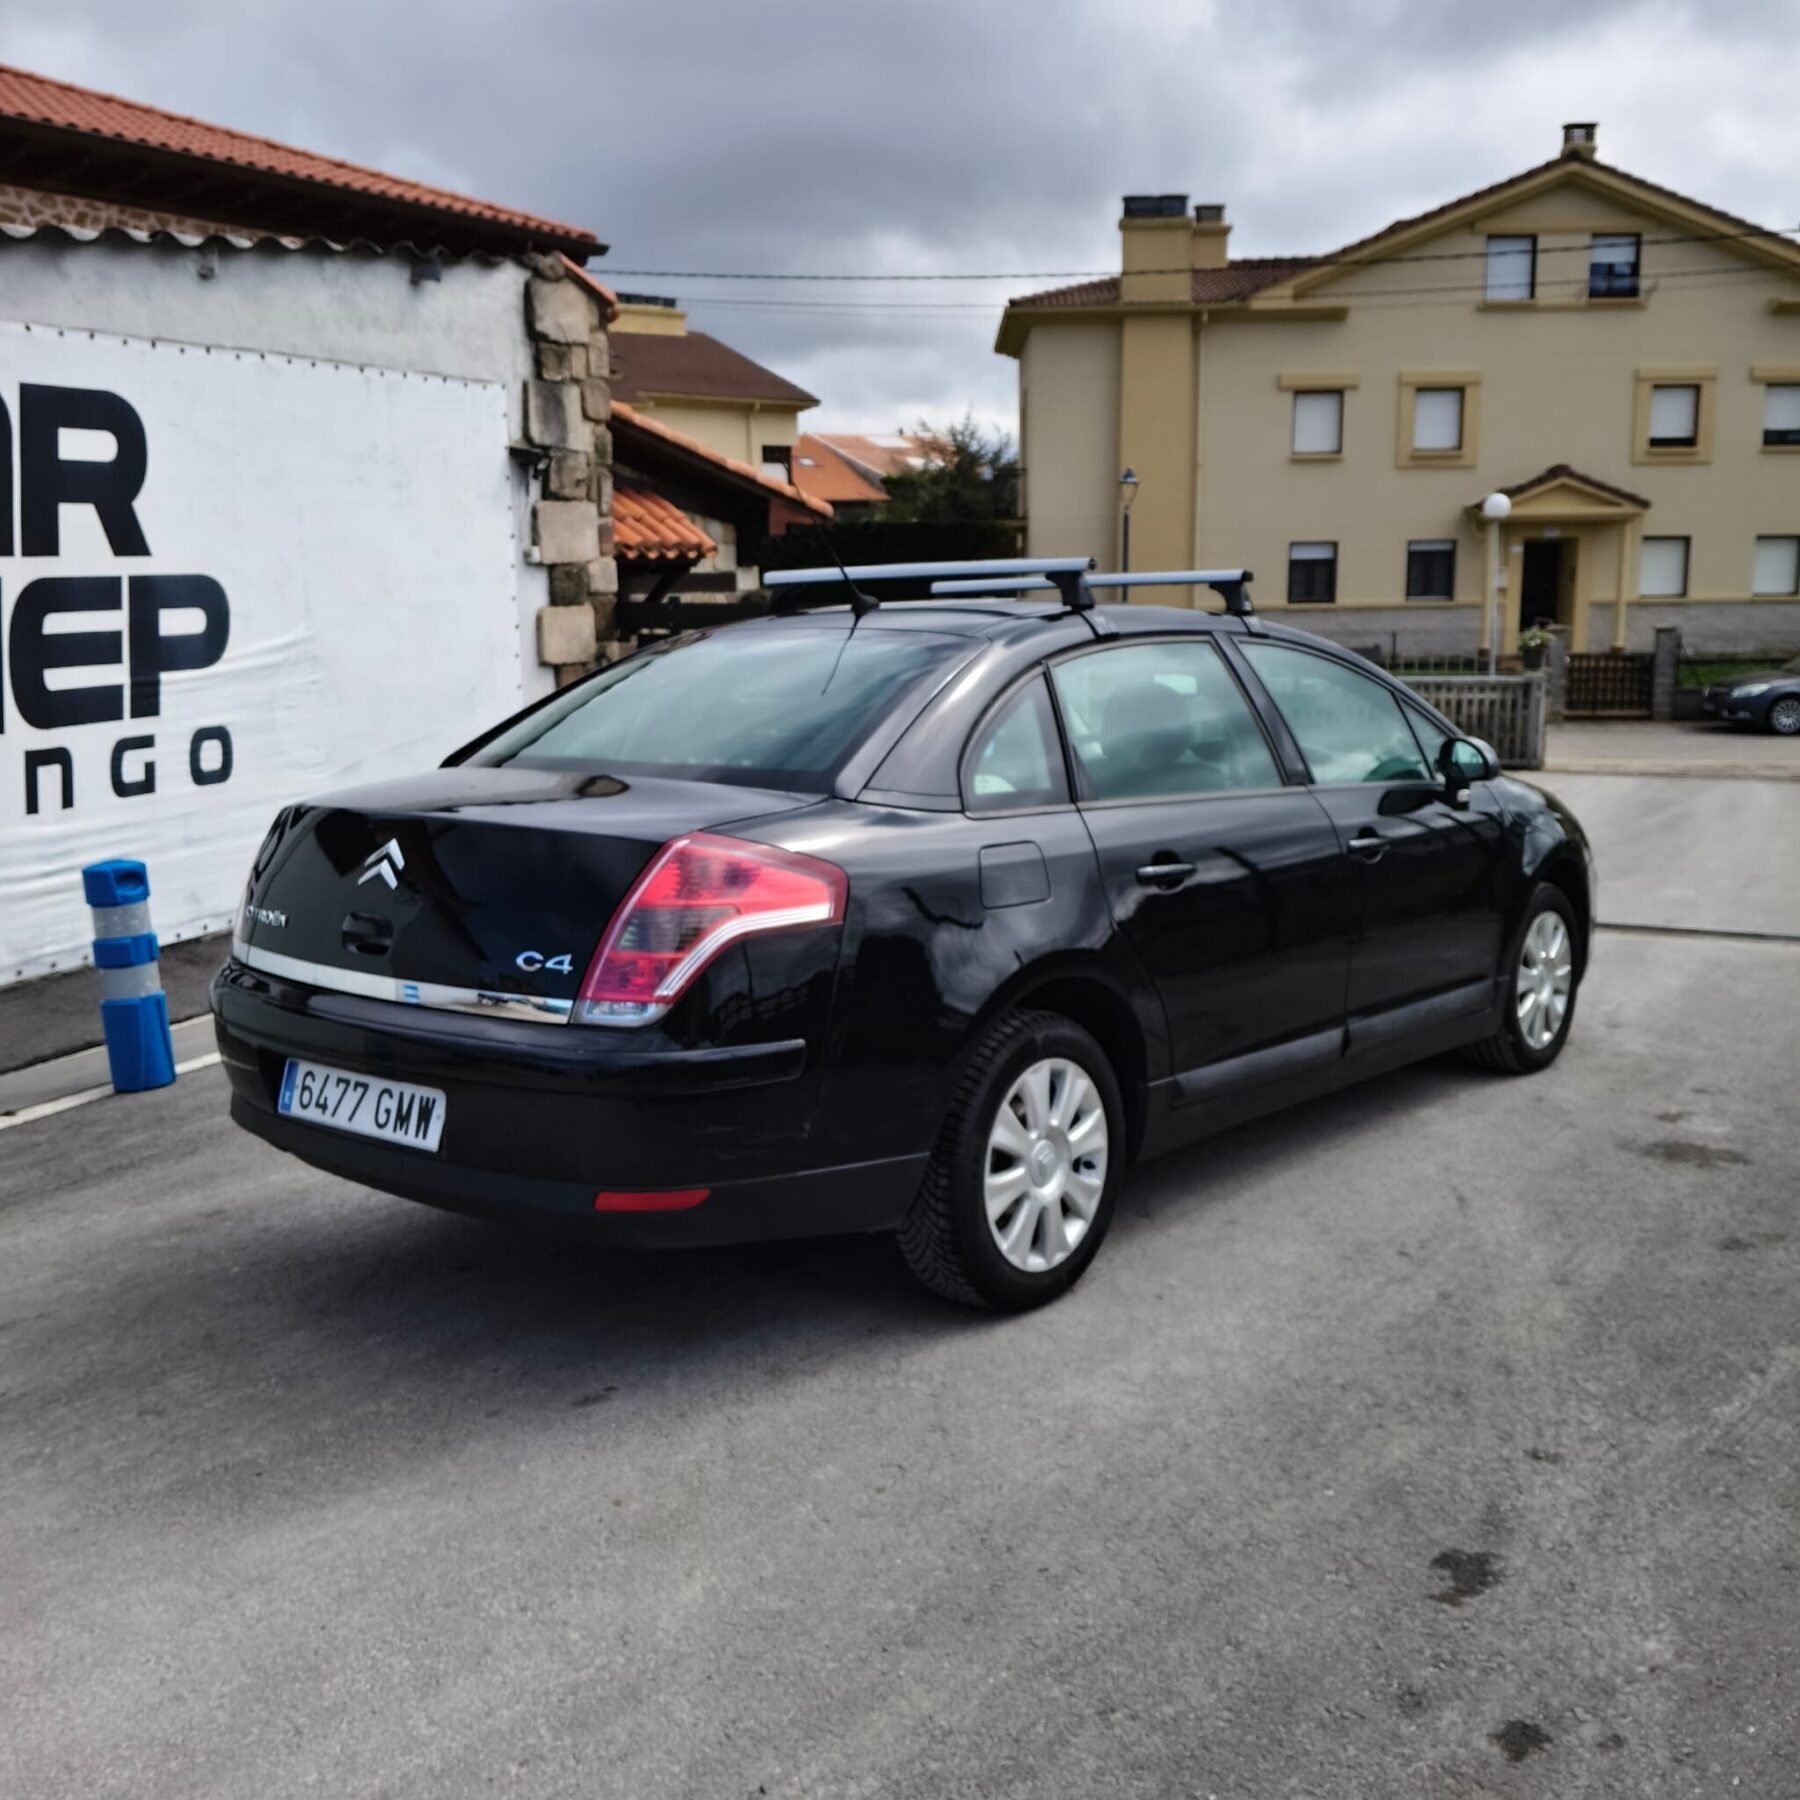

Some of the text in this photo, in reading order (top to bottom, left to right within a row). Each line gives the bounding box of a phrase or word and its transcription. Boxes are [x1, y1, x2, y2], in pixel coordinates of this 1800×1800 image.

[0, 382, 152, 557] R
[0, 574, 231, 734] EP
[515, 950, 574, 975] C4
[299, 1070, 437, 1141] 6477 GMW
